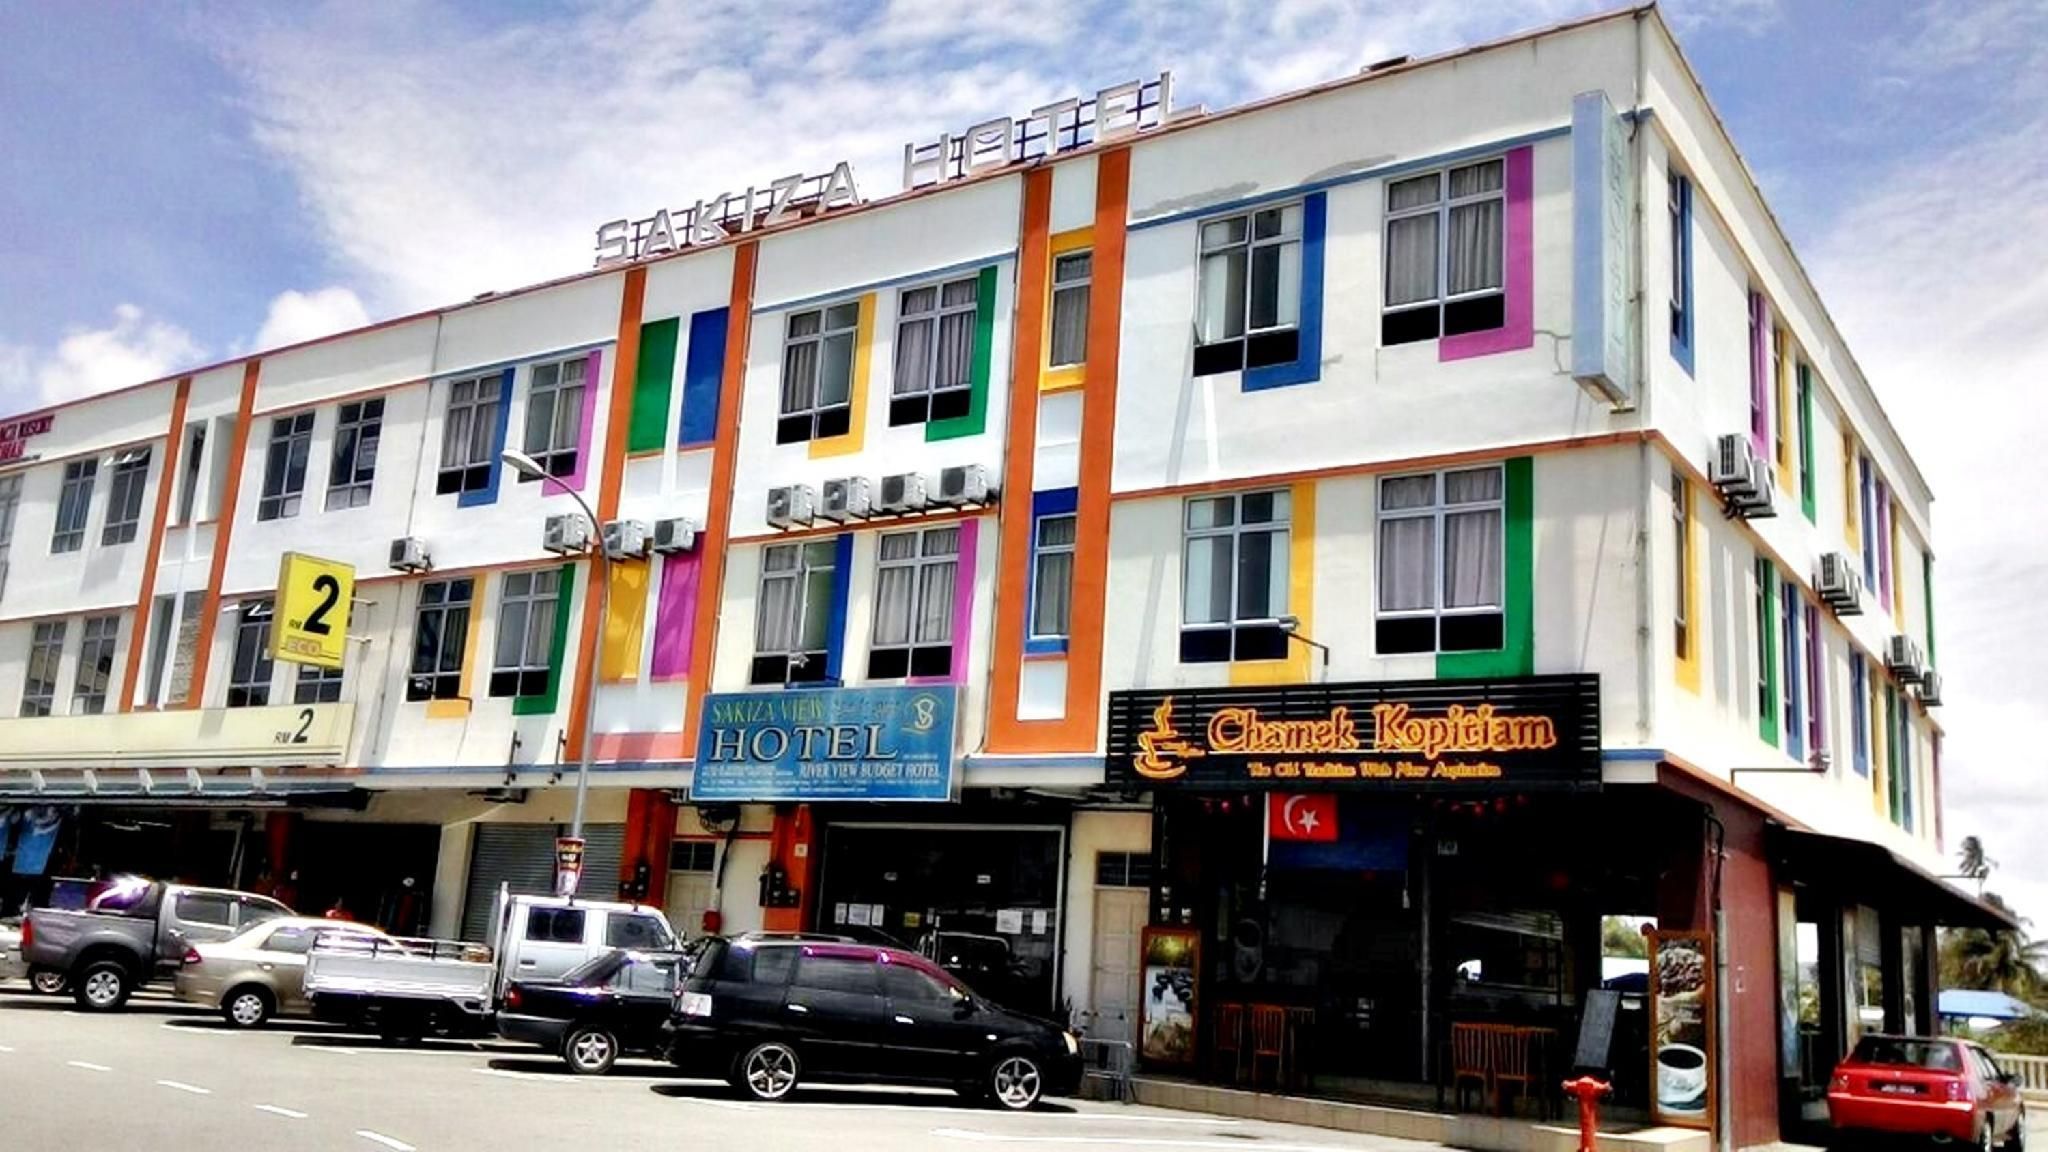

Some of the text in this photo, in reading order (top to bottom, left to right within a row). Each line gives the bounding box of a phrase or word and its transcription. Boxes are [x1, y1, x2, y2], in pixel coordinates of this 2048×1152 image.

[594, 71, 1206, 267] SAKIZA HOTEL
[303, 574, 340, 636] 2
[292, 707, 314, 744] 2
[712, 699, 775, 723] SAKIZA
[781, 696, 823, 721] VIEW
[710, 723, 898, 762] HOTEL
[1208, 703, 1556, 760] Chamek Kopitiam
[801, 762, 829, 778] RIVER
[831, 762, 859, 778] VIEW
[861, 761, 904, 778] BUDGET
[905, 761, 940, 778] HOTEL
